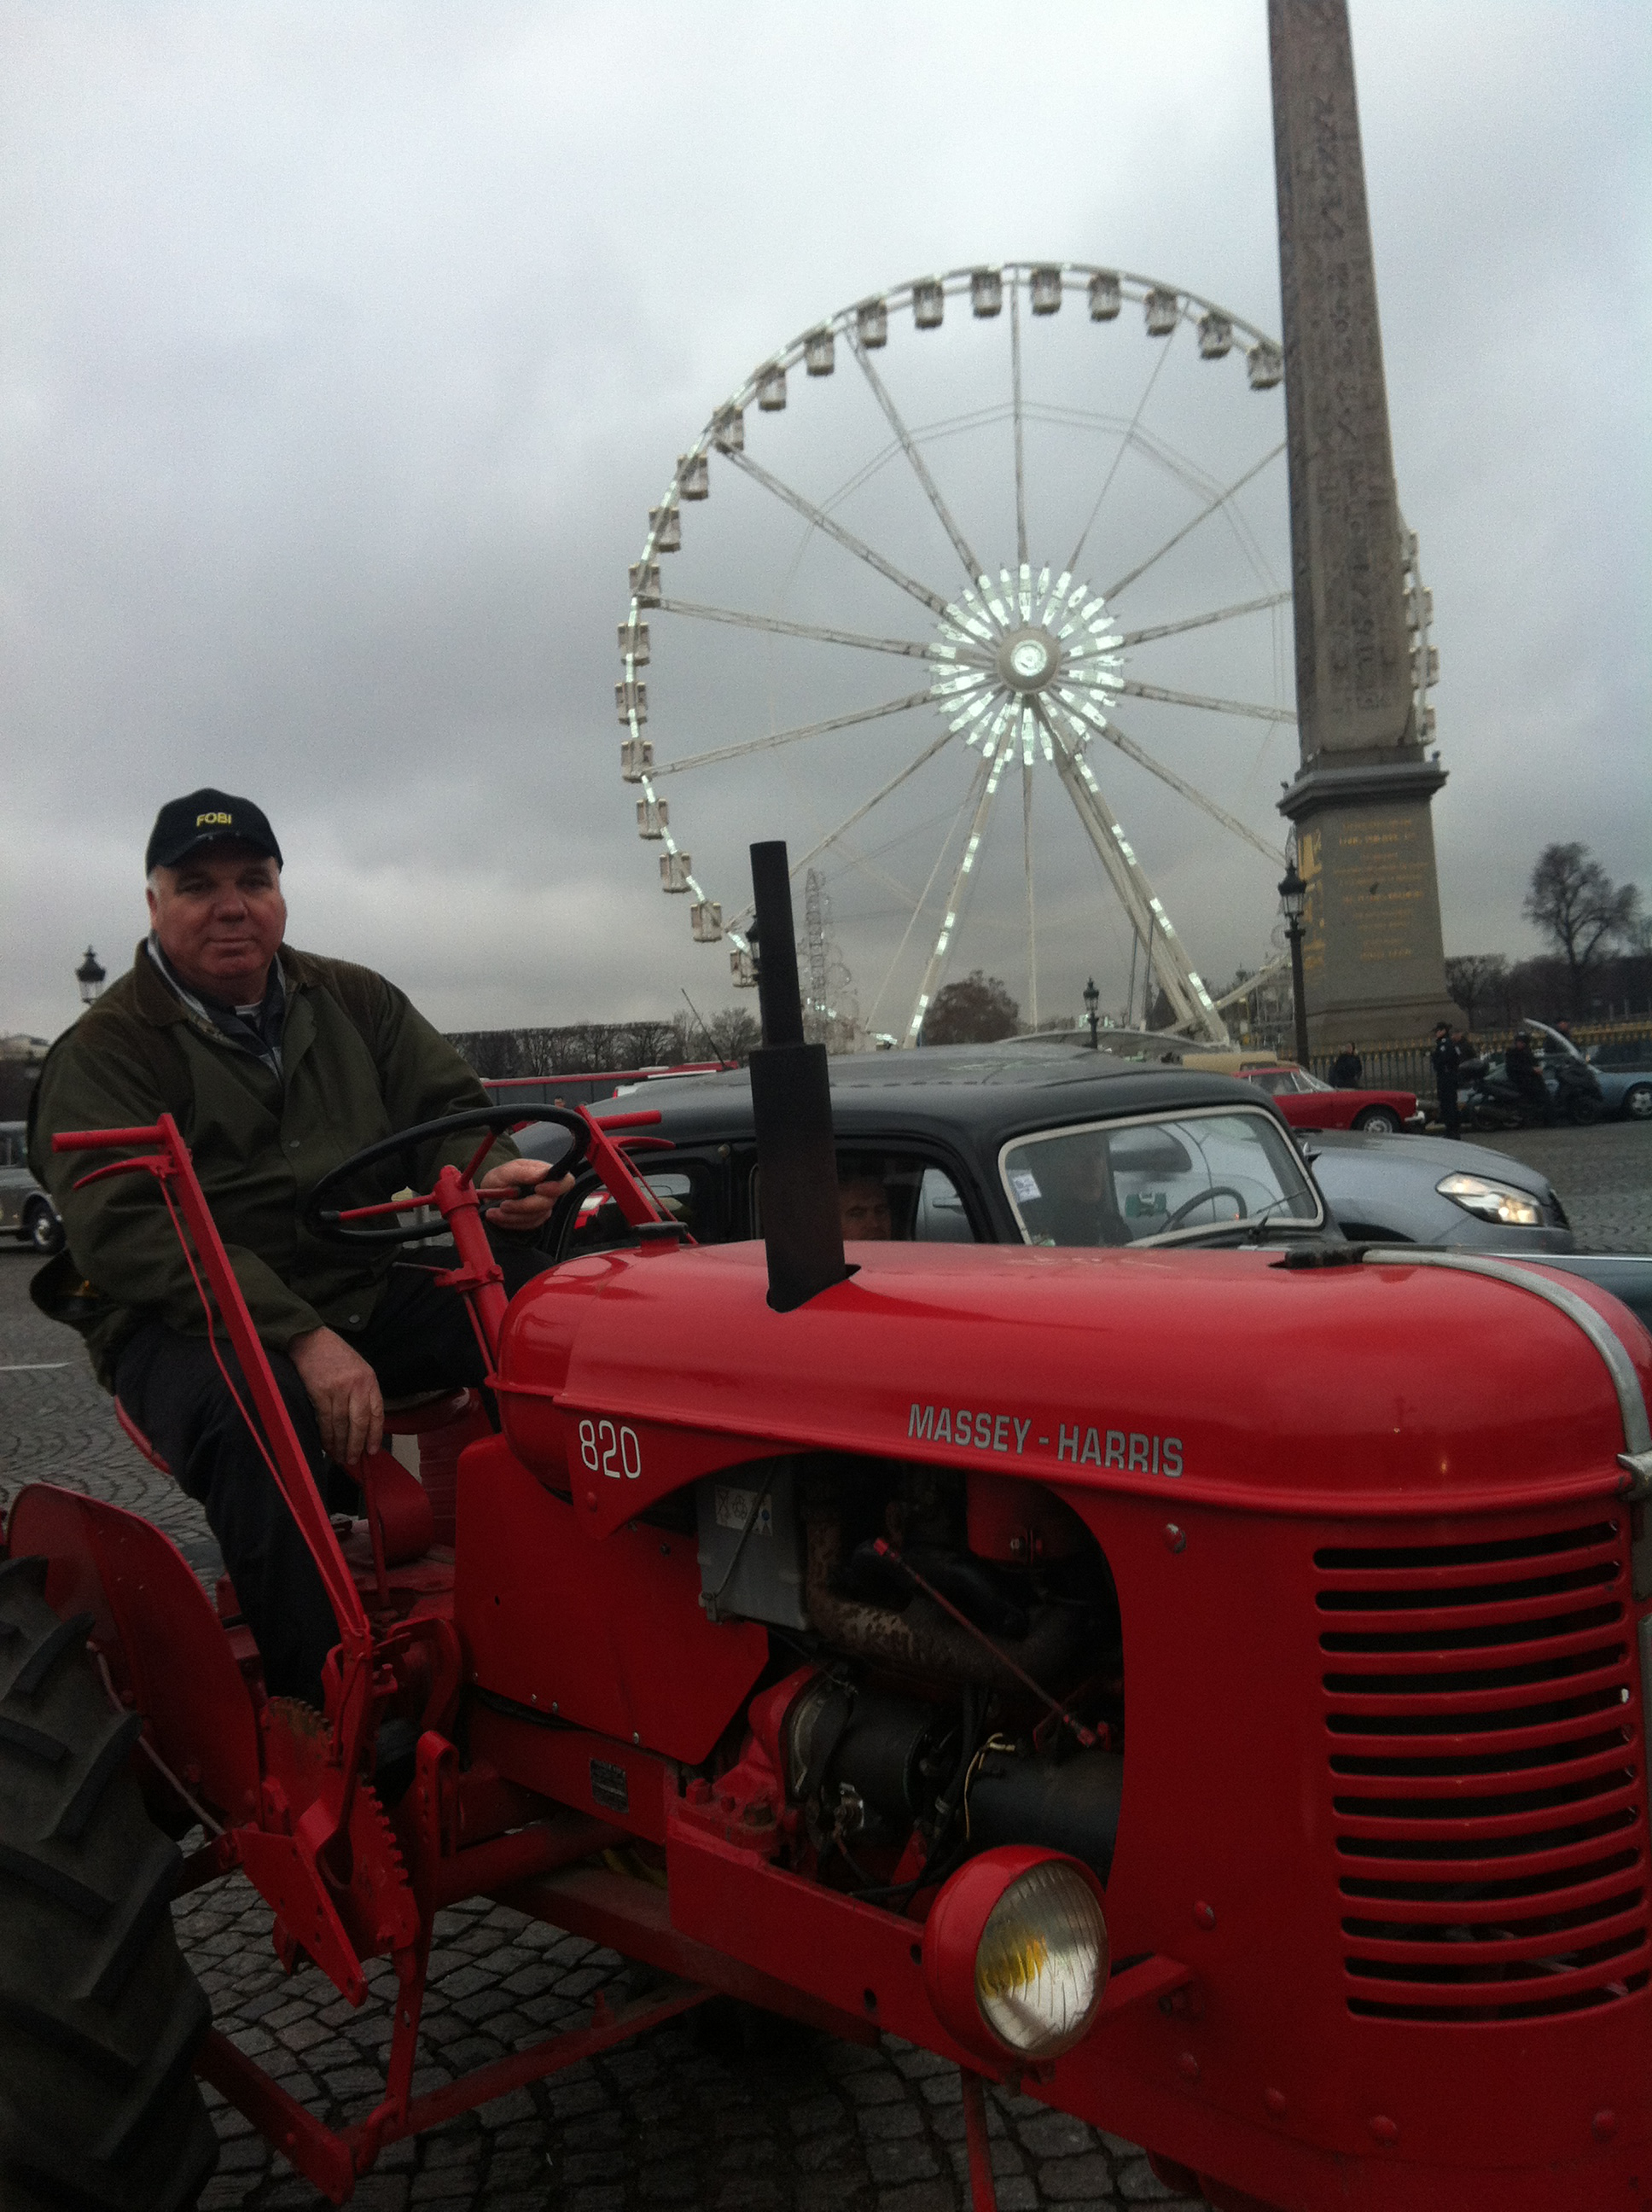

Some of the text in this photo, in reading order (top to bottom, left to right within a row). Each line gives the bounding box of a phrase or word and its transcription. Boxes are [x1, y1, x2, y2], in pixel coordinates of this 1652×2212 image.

[196, 812, 231, 827] FOBI
[579, 1419, 641, 1479] 820
[908, 1403, 1032, 1454] MASSEY
[1057, 1423, 1184, 1478] HARRIS
